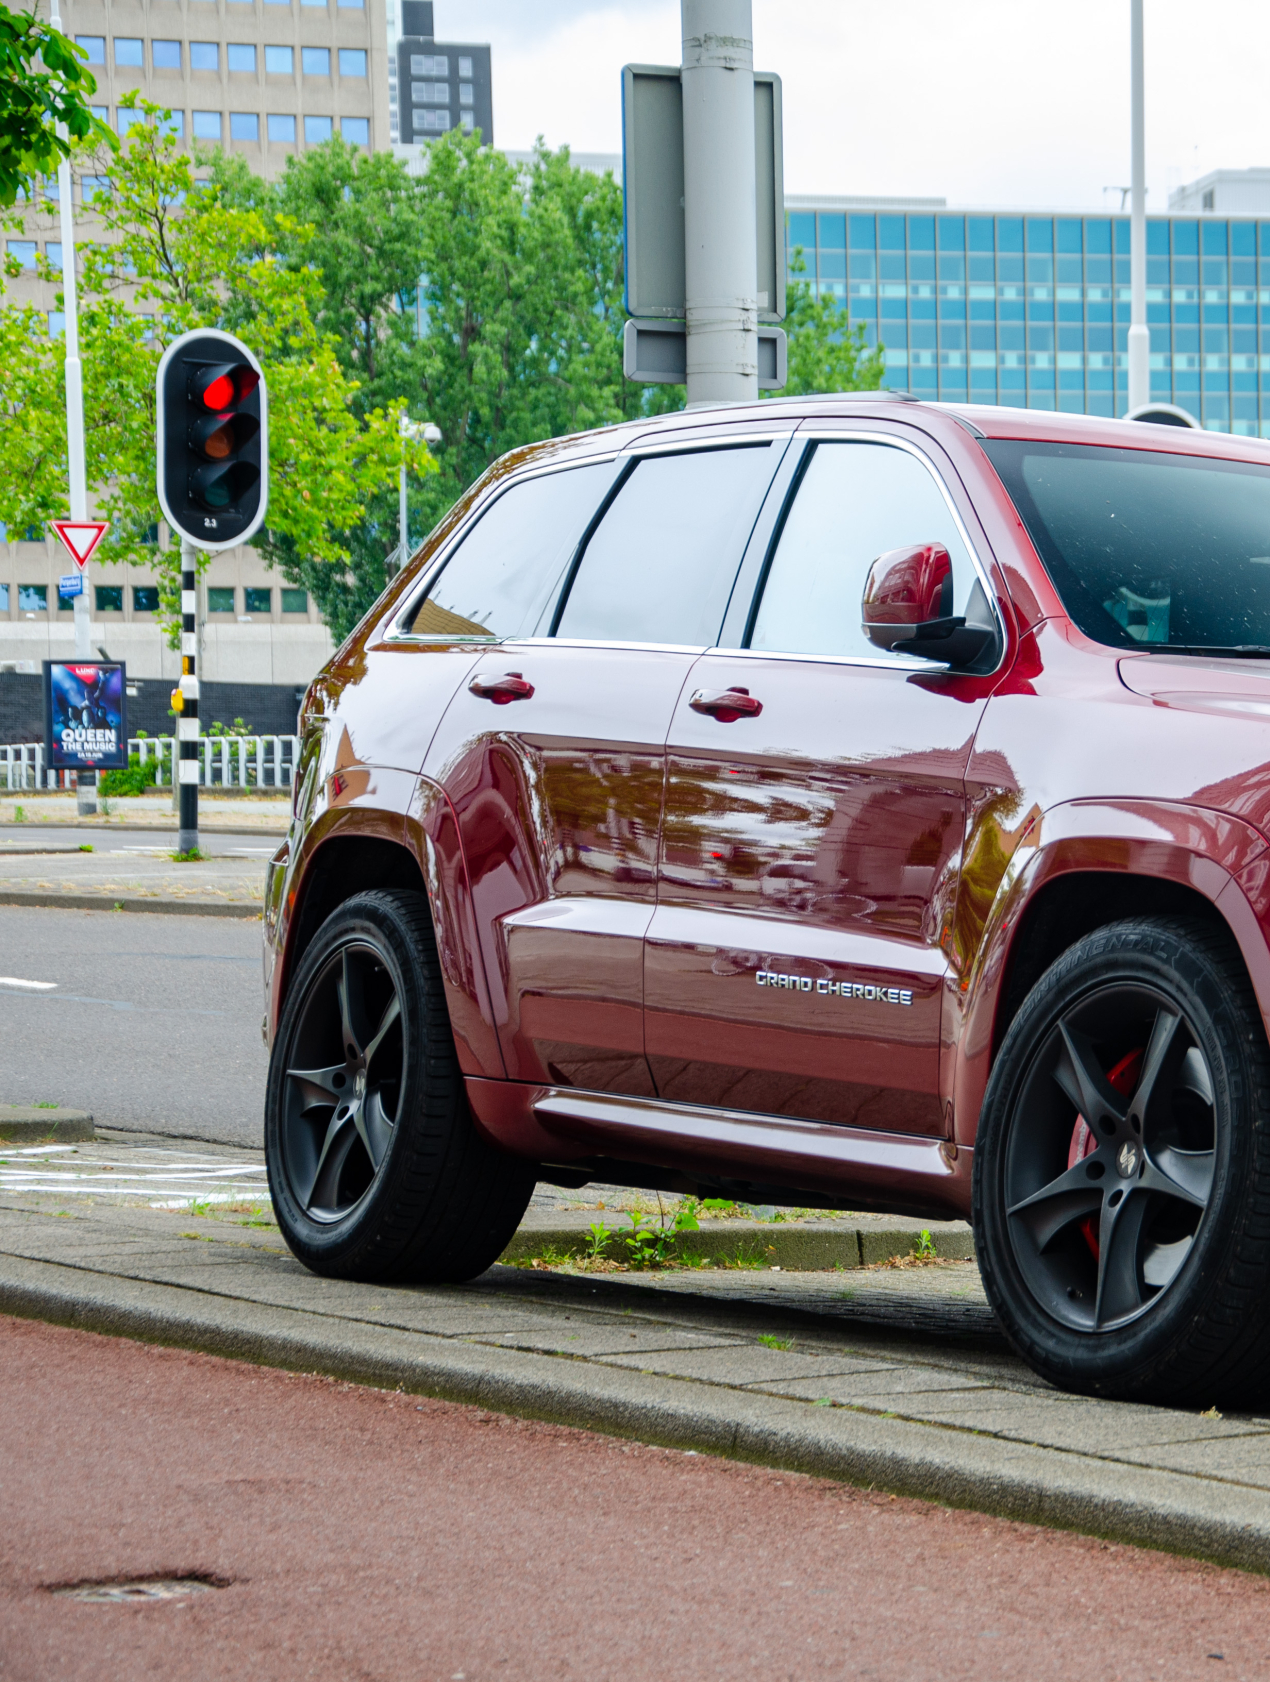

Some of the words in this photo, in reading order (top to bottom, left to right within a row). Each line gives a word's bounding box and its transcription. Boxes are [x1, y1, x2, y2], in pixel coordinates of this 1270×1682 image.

[204, 517, 217, 529] 2.3
[61, 729, 115, 742] QUEEN
[62, 742, 81, 752] THE
[84, 742, 116, 752] MUSIC
[756, 971, 813, 992] GRAND
[816, 979, 913, 1006] CHEROKEE
